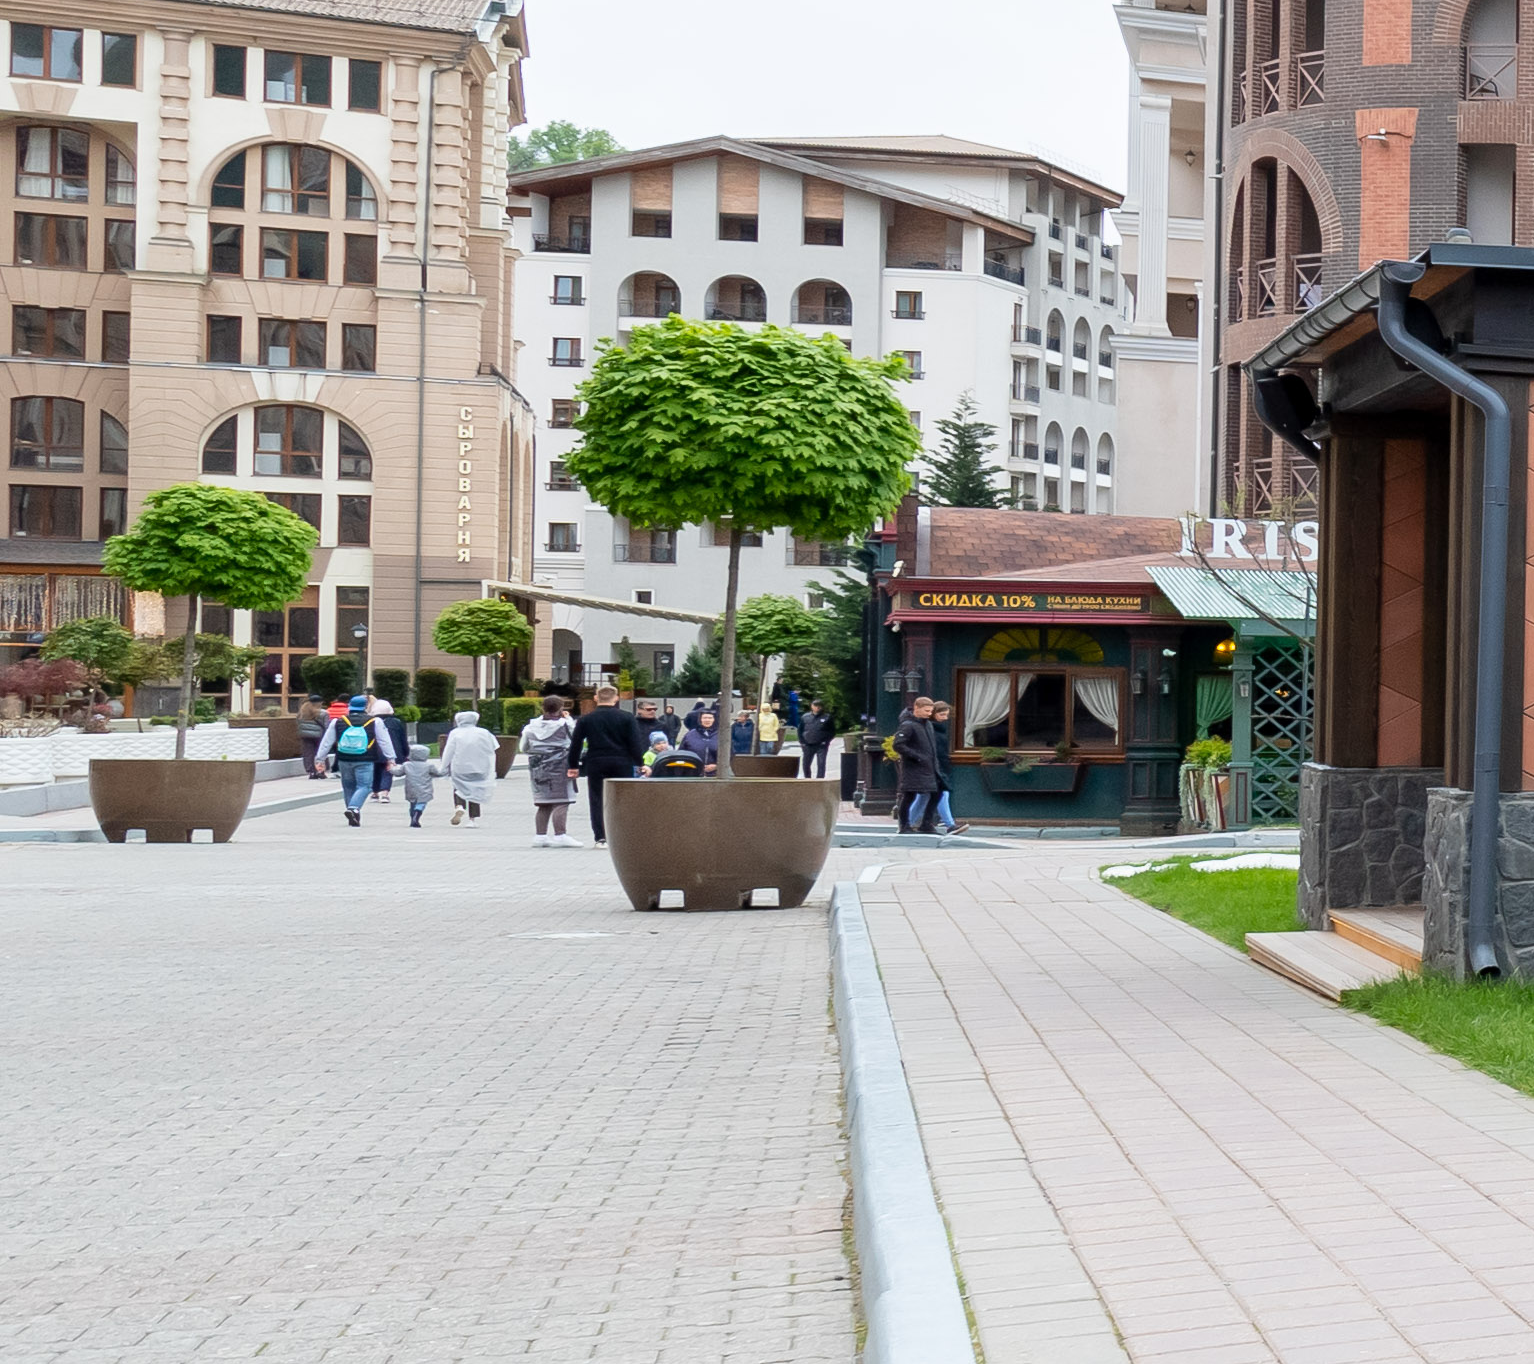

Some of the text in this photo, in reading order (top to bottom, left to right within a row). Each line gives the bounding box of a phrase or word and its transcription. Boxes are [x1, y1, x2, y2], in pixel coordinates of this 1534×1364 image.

[457, 406, 473, 562] СЫРОВАРНЯ
[919, 593, 1036, 608] СКИДКА 10%
[1047, 596, 1141, 605] НА БЛЮДА КУХНИ
